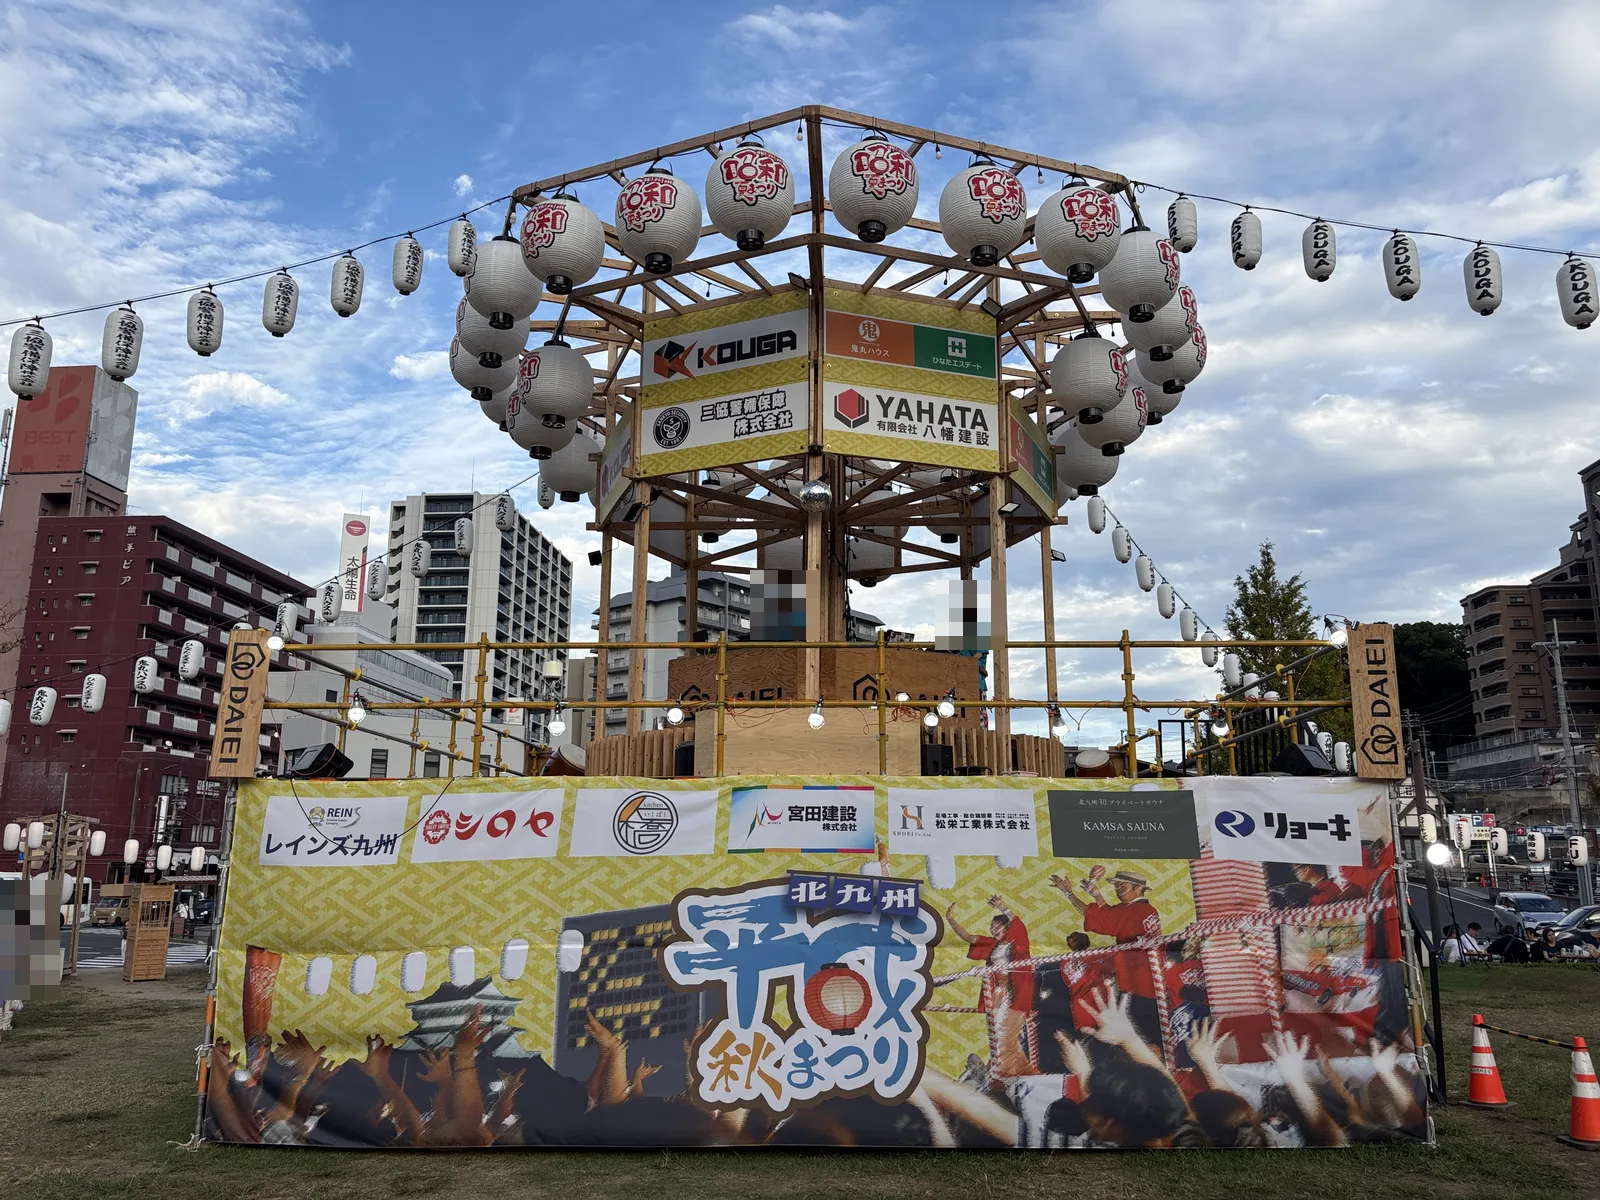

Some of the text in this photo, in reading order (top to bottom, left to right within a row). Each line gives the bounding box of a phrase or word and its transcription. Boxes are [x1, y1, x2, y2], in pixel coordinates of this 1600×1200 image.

[723, 150, 787, 186] 昭和
[854, 145, 915, 184] 昭和
[1168, 202, 1182, 247] KOUGA
[1231, 216, 1246, 263] KOUGA
[1313, 224, 1330, 269] KOUGA
[1392, 237, 1415, 287] KOUGA
[1472, 249, 1495, 301] KOUGA
[1568, 262, 1594, 316] KOUGA
[697, 329, 797, 369] KOUGA
[851, 344, 890, 358] 鬼丸ハウス
[931, 356, 983, 371] ひなたエステート
[700, 388, 787, 422] 三協警備保障
[875, 394, 989, 432] YAHATA
[24, 429, 77, 445] BEST
[733, 409, 794, 439] 株式会社
[876, 420, 990, 447] 有限会社 八幡建設
[344, 556, 360, 601] 太陽生命
[1365, 639, 1391, 718] DAIEI
[219, 686, 249, 764] DAIEI
[643, 800, 664, 808] kitchen
[787, 804, 858, 822] 宮田建設
[1472, 815, 1482, 826] P
[822, 822, 858, 832] 株式会社
[935, 819, 1031, 831] 松栄工業株式会社
[1083, 821, 1166, 832] KAMSA SAUNA
[1263, 811, 1352, 842] リョーキ
[265, 833, 398, 857] レインズ九州
[791, 880, 917, 910] 北九州
[706, 1028, 910, 1102] 秋まつり
